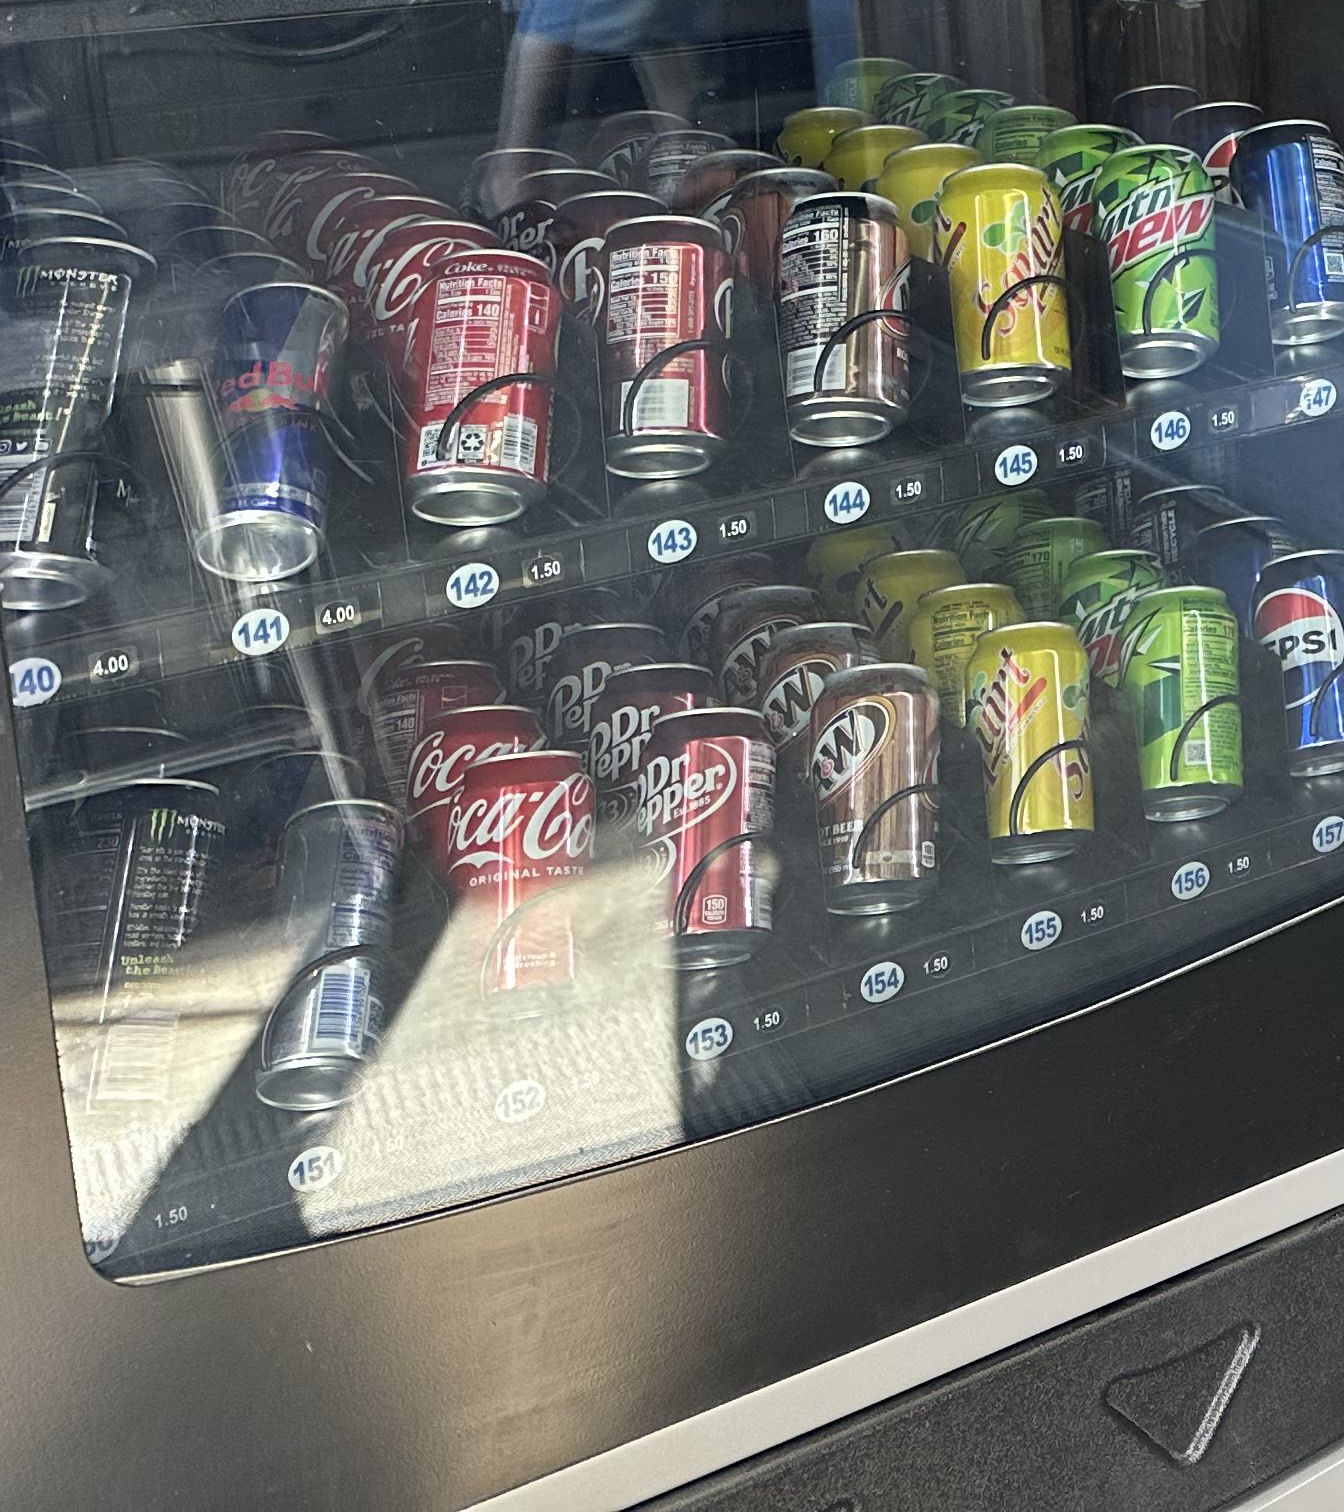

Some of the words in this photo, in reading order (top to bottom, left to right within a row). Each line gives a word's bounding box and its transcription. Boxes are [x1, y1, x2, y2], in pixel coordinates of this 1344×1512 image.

[813, 228, 839, 242] 160
[439, 278, 475, 290] Nutrition
[478, 277, 502, 289] Facts
[445, 261, 488, 276] Coke
[651, 272, 679, 285] 150
[436, 306, 473, 320] Calories
[477, 303, 500, 317] 140
[1154, 416, 1188, 443] 146
[1212, 410, 1236, 428] 1.50
[998, 452, 1034, 480] 145
[1058, 445, 1083, 462] 1.50
[828, 490, 867, 515] 144
[896, 480, 922, 499] 1.50
[652, 528, 693, 555] 143
[719, 519, 747, 538] 1.50
[450, 571, 494, 600] 142
[531, 560, 561, 579] 1.50
[238, 615, 284, 649] 141
[322, 605, 356, 626] 4.00
[1264, 627, 1340, 665] EPSI
[93, 654, 129, 677] 4.00
[832, 820, 865, 834] BEER
[1315, 820, 1344, 847] 157
[468, 867, 541, 887] ORIGINAL
[546, 864, 586, 877] TASTE
[1174, 867, 1206, 894] 156
[1228, 856, 1250, 875] 1.50
[1024, 917, 1058, 945] 155
[1081, 905, 1105, 924] 1.50
[863, 968, 900, 998] 154
[923, 955, 949, 975] 1.50
[688, 1024, 729, 1056] 153
[753, 1010, 782, 1031] 1.50
[292, 1152, 339, 1184] 151
[154, 1205, 189, 1229] 1.50
